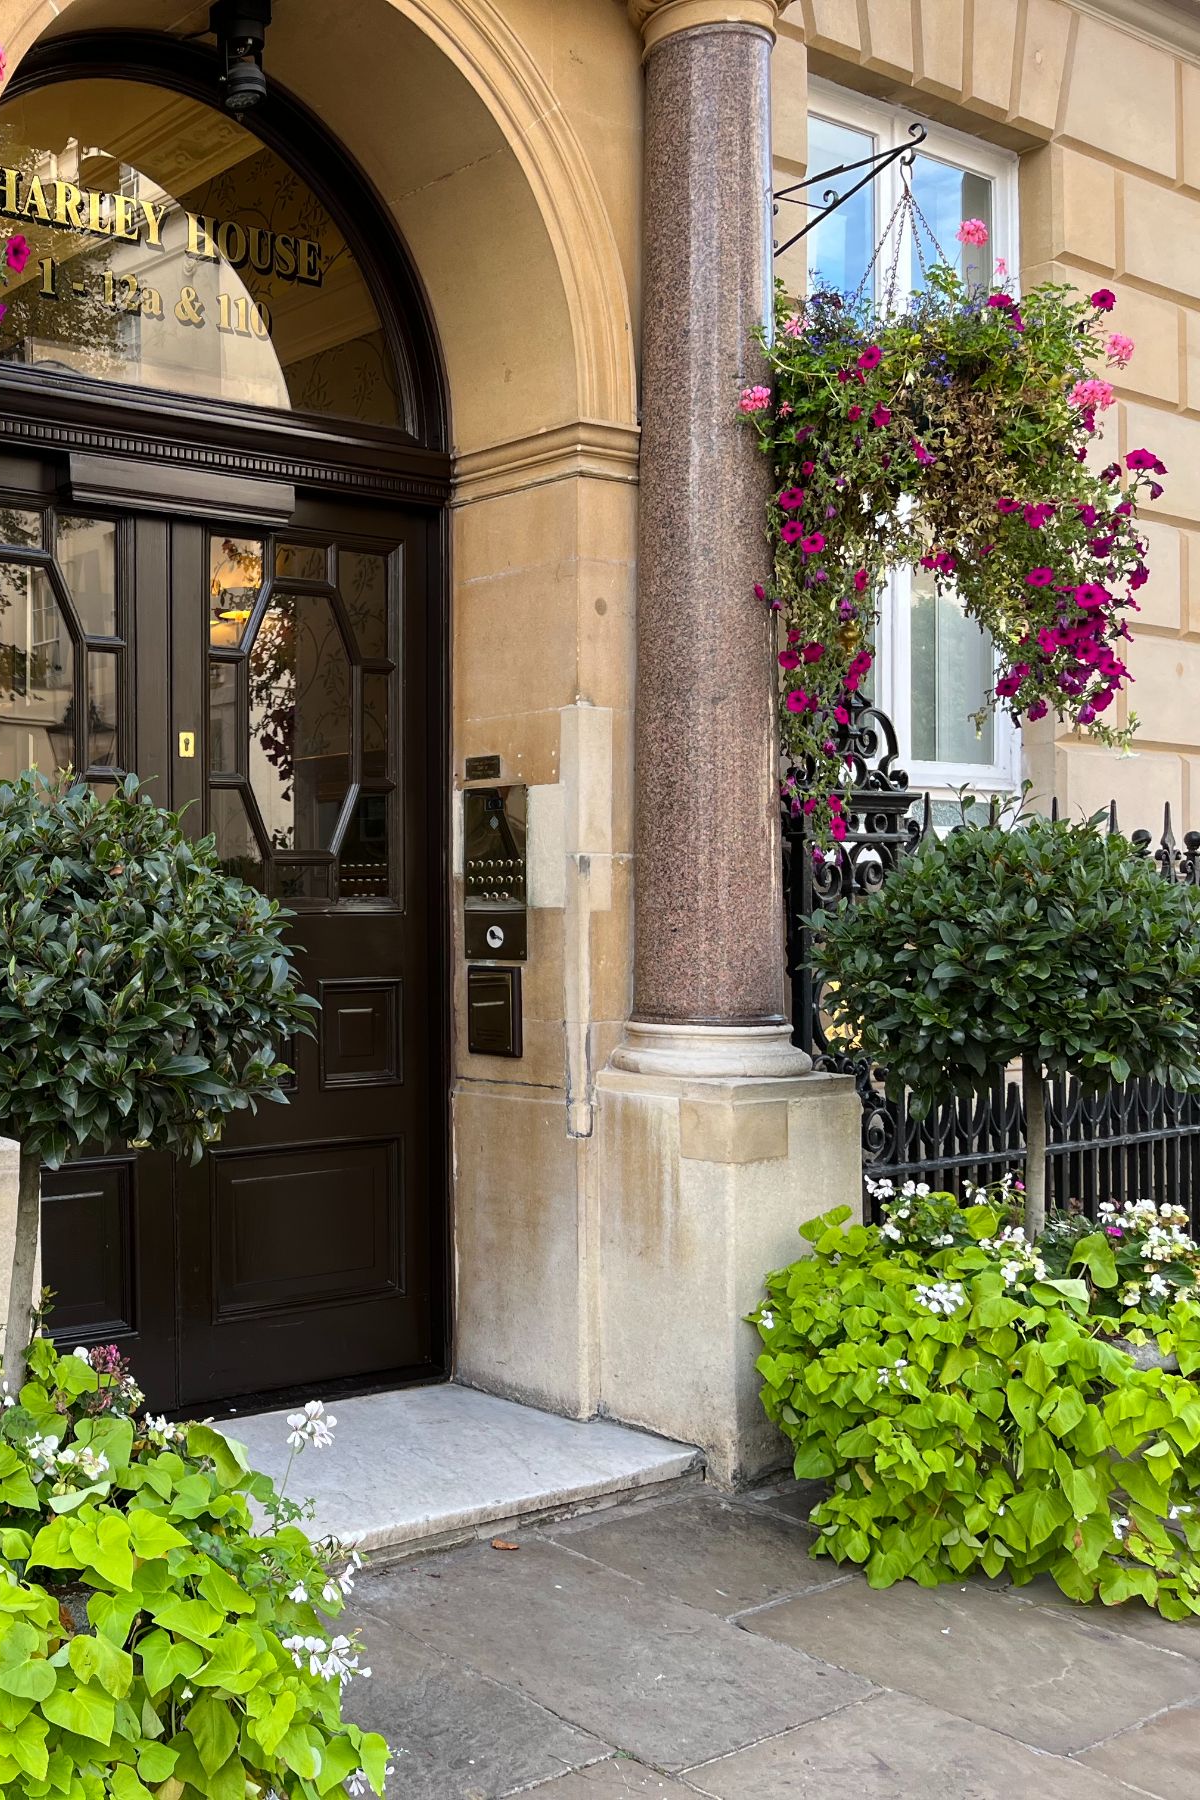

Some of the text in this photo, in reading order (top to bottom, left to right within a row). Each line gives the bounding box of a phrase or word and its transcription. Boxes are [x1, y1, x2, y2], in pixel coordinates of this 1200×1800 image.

[185, 211, 323, 284] HOUSE
[38, 256, 55, 297] 1
[102, 269, 162, 316] 12a
[174, 286, 202, 324] &
[216, 293, 271, 338] 110
